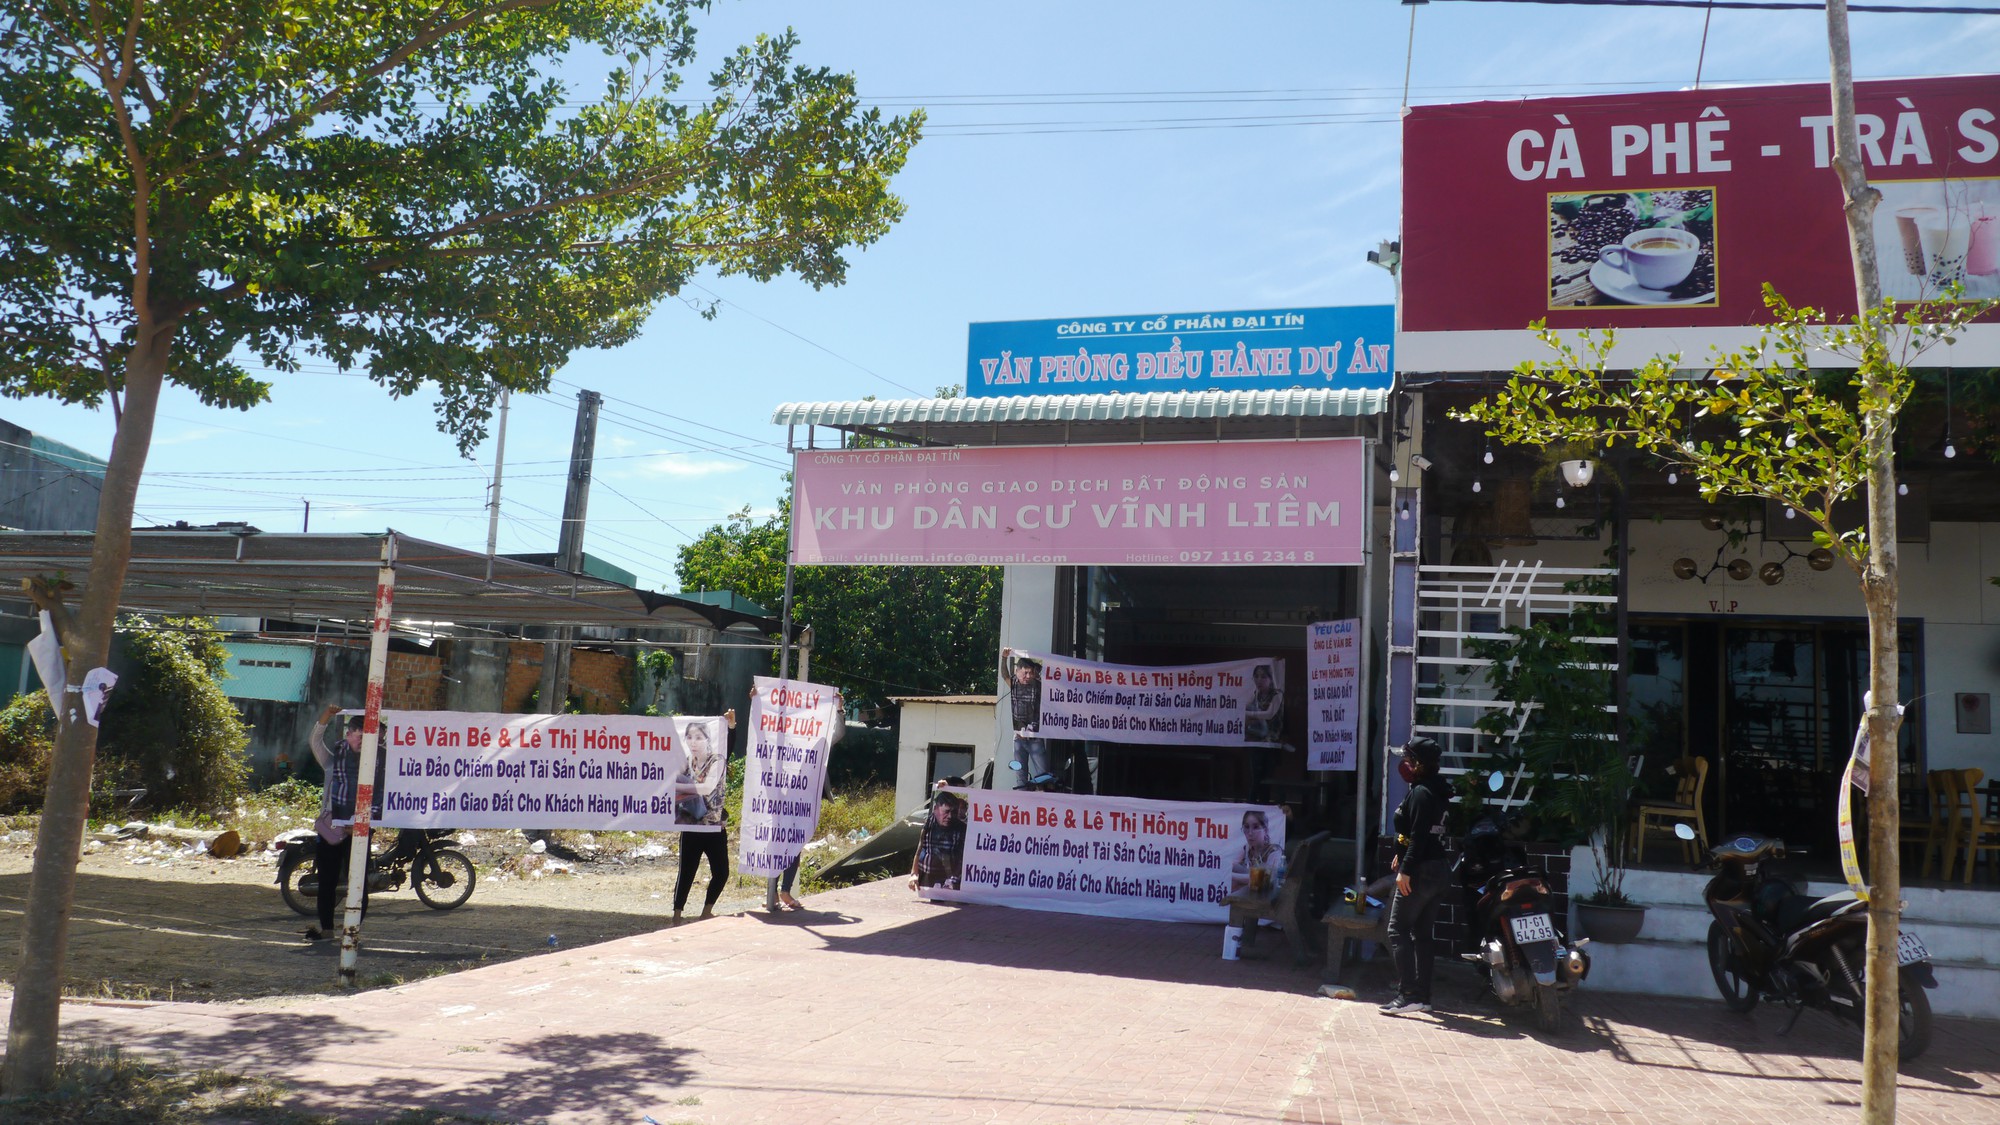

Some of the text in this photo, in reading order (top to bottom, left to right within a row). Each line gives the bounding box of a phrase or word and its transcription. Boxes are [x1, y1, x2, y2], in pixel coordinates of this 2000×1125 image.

[1506, 114, 1585, 181] CÀ
[1611, 106, 1731, 177] PHÊ
[1800, 97, 1933, 168] TRÀ
[1056, 321, 1106, 334] CÔNG
[1112, 321, 1135, 332] TY
[1232, 316, 1265, 329] ĐẠI
[1272, 312, 1304, 325] TÍN
[979, 336, 1390, 385] VĂN PHÒNG ĐIỀU HÀNH DỰ ÁN
[814, 452, 844, 465] CÔNG
[849, 453, 863, 464] TY
[917, 452, 937, 463] ĐẠI
[941, 449, 961, 462] TÍN
[841, 472, 1309, 495] VĂN PHÒNG GIAO DỊCH BẤT ĐỘNG SẢN
[814, 492, 1341, 531] KHU DÂN CƯ VĨNH LIÊM
[808, 553, 848, 563] Email:
[1126, 552, 1173, 563] Hotline:
[1179, 550, 1213, 562] 097
[1221, 550, 1254, 562] 116
[1262, 550, 1296, 562] 234
[1304, 550, 1315, 561] 8
[1045, 666, 1242, 690] Lê Văn Bé & Lê Thị Hồng Thu
[770, 685, 820, 711] CÔNG LÝ
[1049, 687, 1237, 710] Lừa Đảo Chiếm Đoạt Tài Sản Của Nhân Dân
[760, 712, 823, 742] PHÁP LUẬT
[1042, 712, 1242, 736] Không Bàn Giao Đất Cho Khách Hàng Mua Đất
[393, 725, 671, 755] Lê Văn Bé & Lê Thị Hồng Thu
[755, 742, 774, 760] HÃY
[805, 750, 819, 769] TRỊ
[399, 755, 664, 783] Lừa Đảo Chiếm Đoạt Tài Sản Của Nhân Dân
[760, 766, 772, 787] KẺ
[790, 769, 808, 791] ĐẢO
[387, 789, 672, 817] Không Bàn Giao Đất Cho Khách Hàng Mua Đất
[767, 799, 782, 815] BAO
[782, 801, 794, 816] GIA
[794, 801, 811, 818] ĐÌNH
[754, 823, 806, 844] LÂM VÀO CẢNH
[973, 803, 1228, 841] Lê Văn Bé & Lê Thị Hồng Thu
[746, 852, 756, 874] NỢ
[975, 832, 1221, 869] Lừa Đảo Chiếm Đoạt Tài Sản Của Nhân Dân
[965, 863, 1228, 903] Không Bàn Giao Đất Cho Khách Hàng Mua Đất
[1516, 927, 1552, 942] 542.95
[1517, 916, 1545, 929] 77-G1
